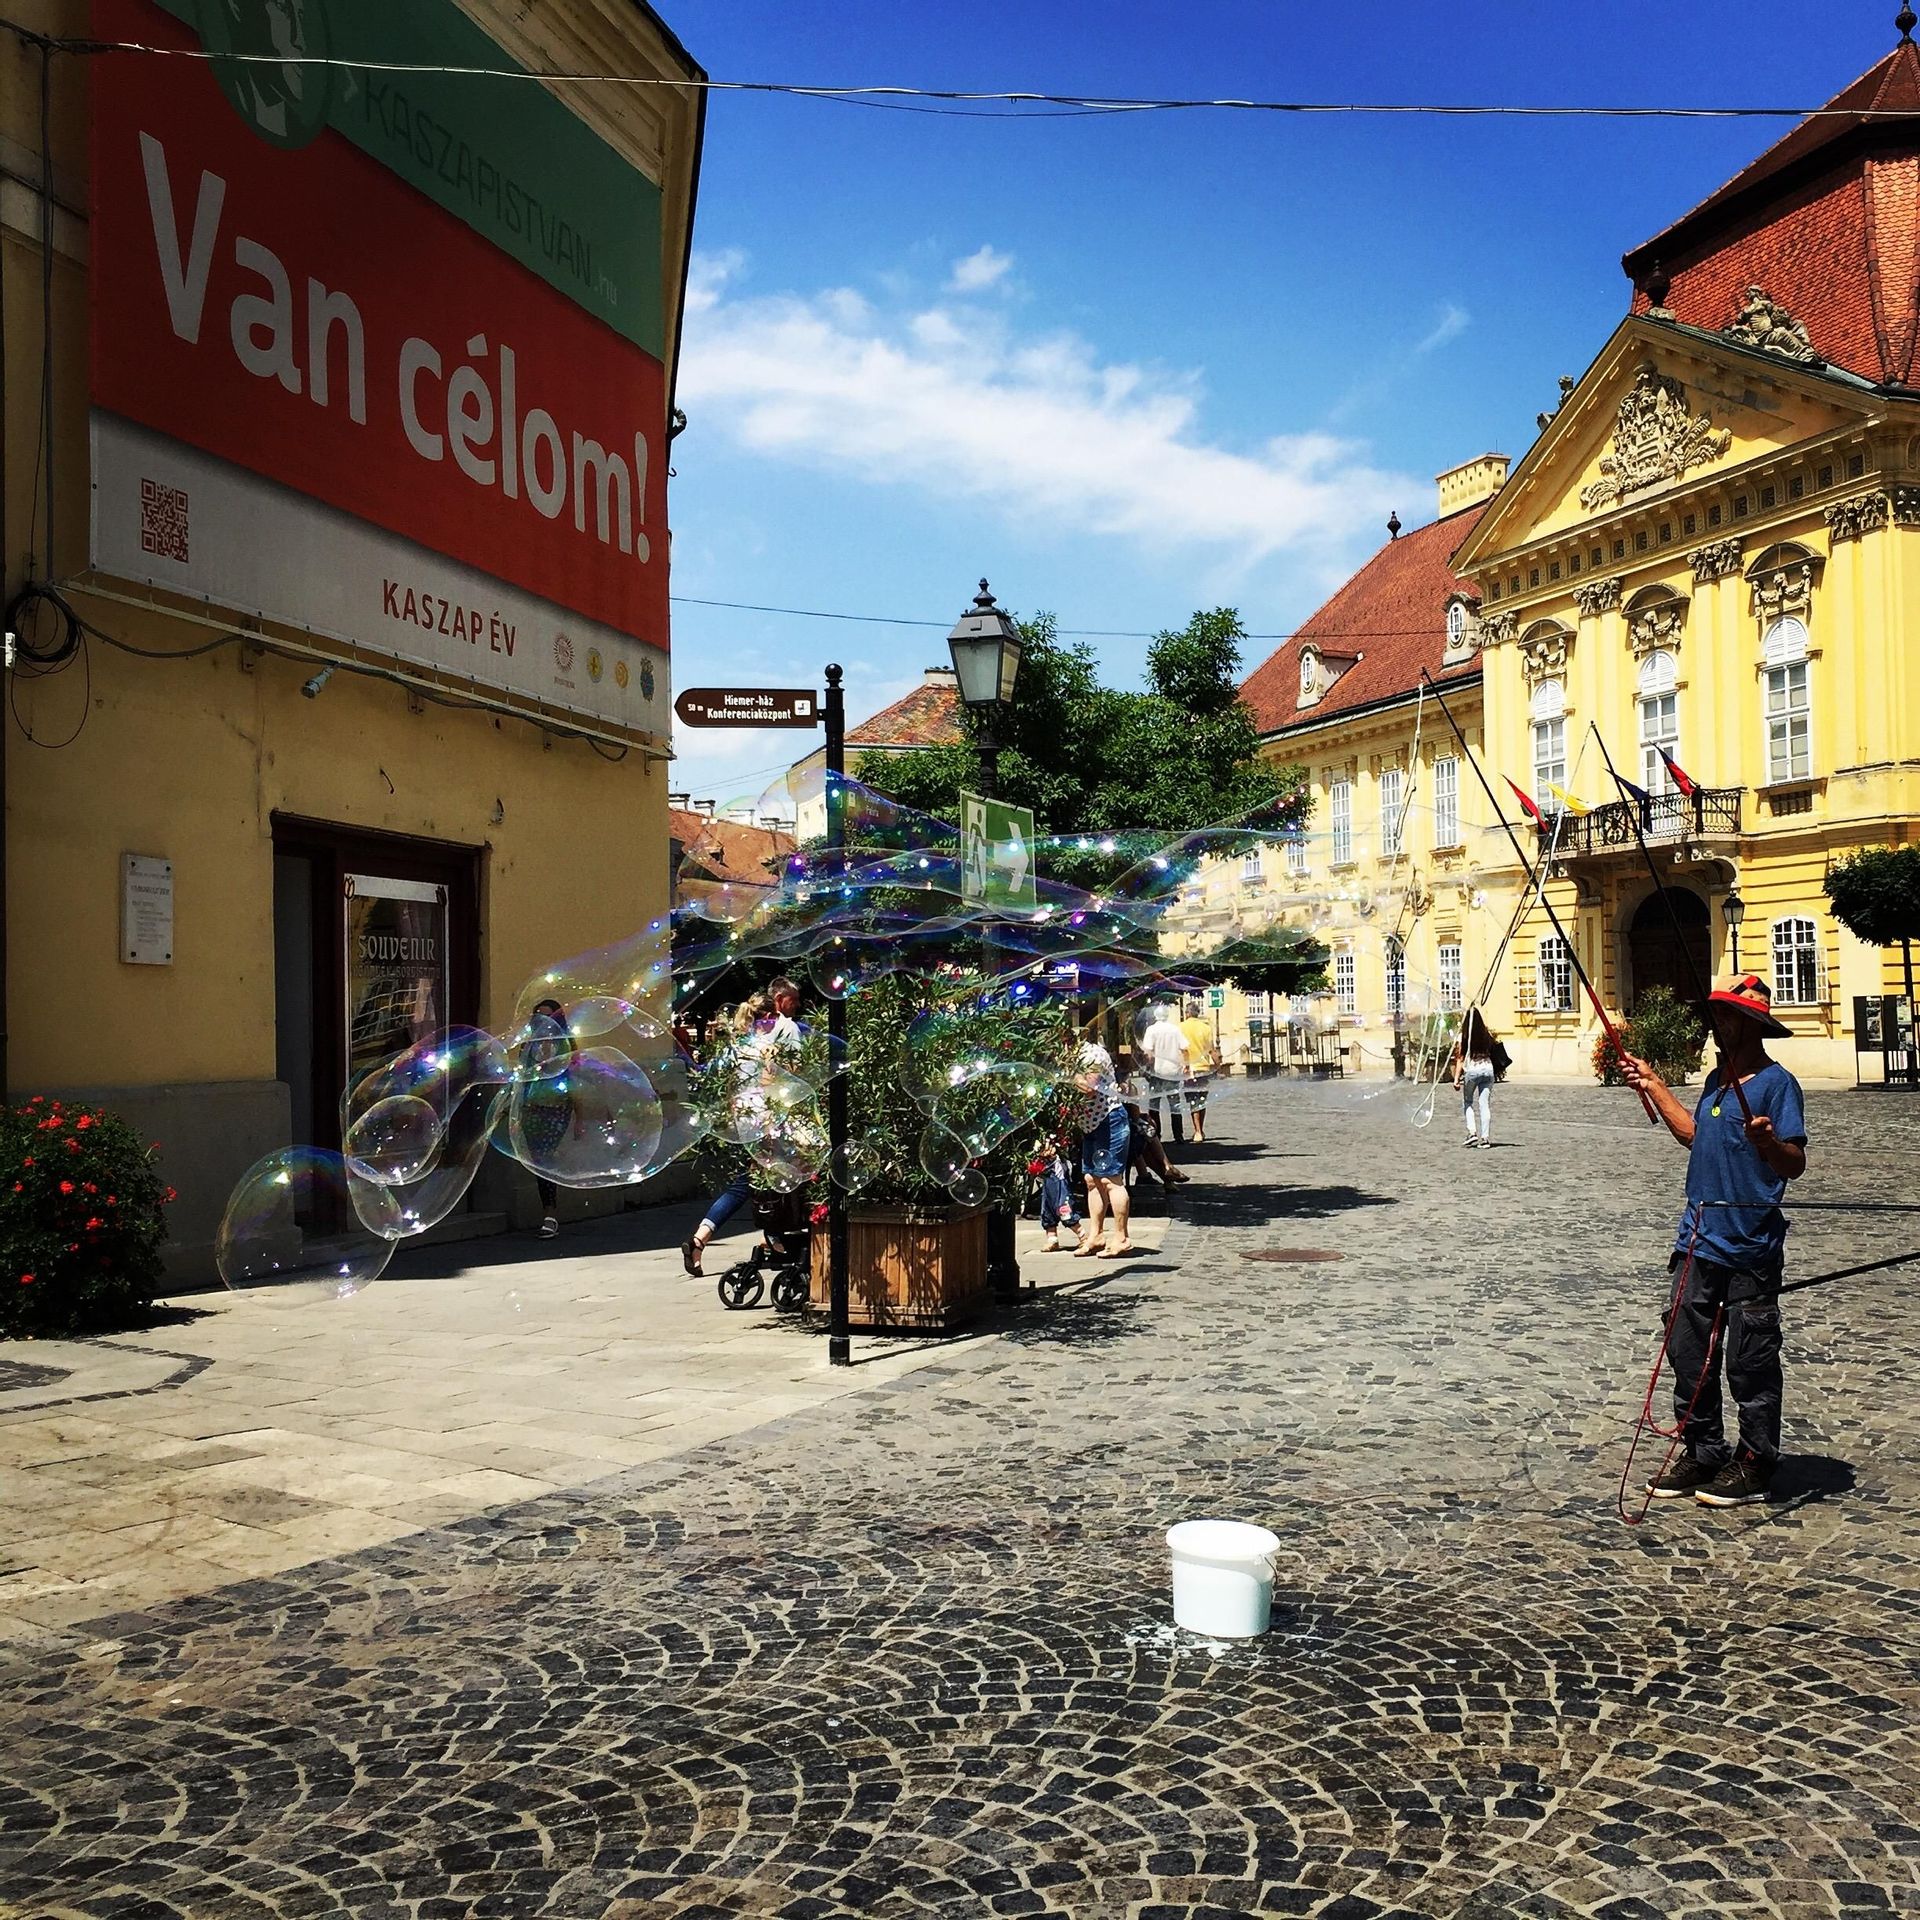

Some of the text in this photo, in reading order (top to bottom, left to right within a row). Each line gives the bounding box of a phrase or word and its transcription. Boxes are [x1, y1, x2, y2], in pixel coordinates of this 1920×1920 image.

[139, 130, 651, 564] Van célom!
[724, 694, 774, 706] Hiemer-ház
[707, 708, 791, 721] Konferenciaközpont
[358, 934, 436, 961] SOUVENIR
